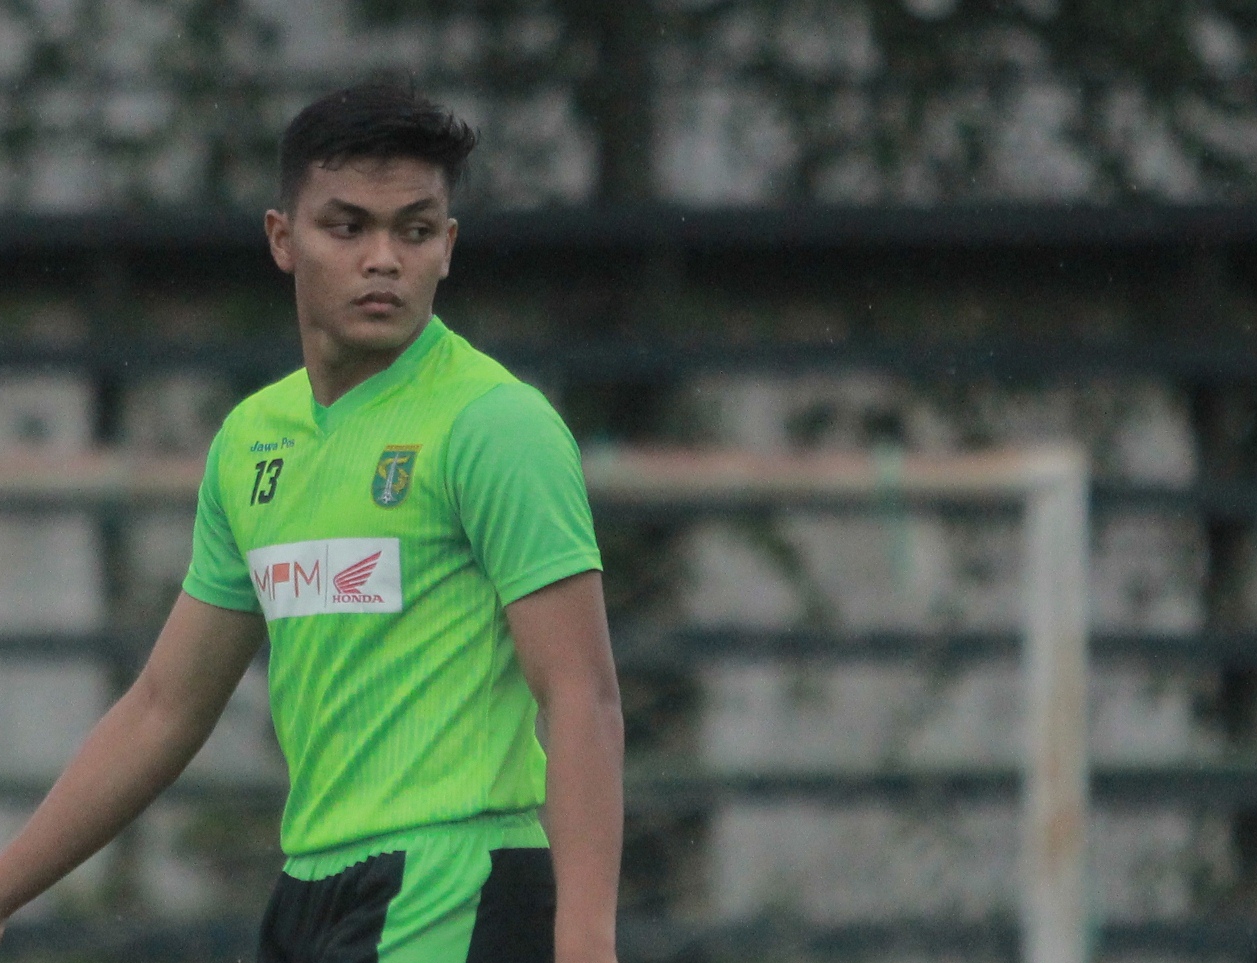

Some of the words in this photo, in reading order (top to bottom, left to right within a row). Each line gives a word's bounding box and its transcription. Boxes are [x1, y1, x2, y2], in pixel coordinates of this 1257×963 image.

[250, 441, 278, 452] Jawa
[250, 458, 284, 506] 13
[254, 559, 320, 601] MPM
[332, 594, 385, 604] HONDA
